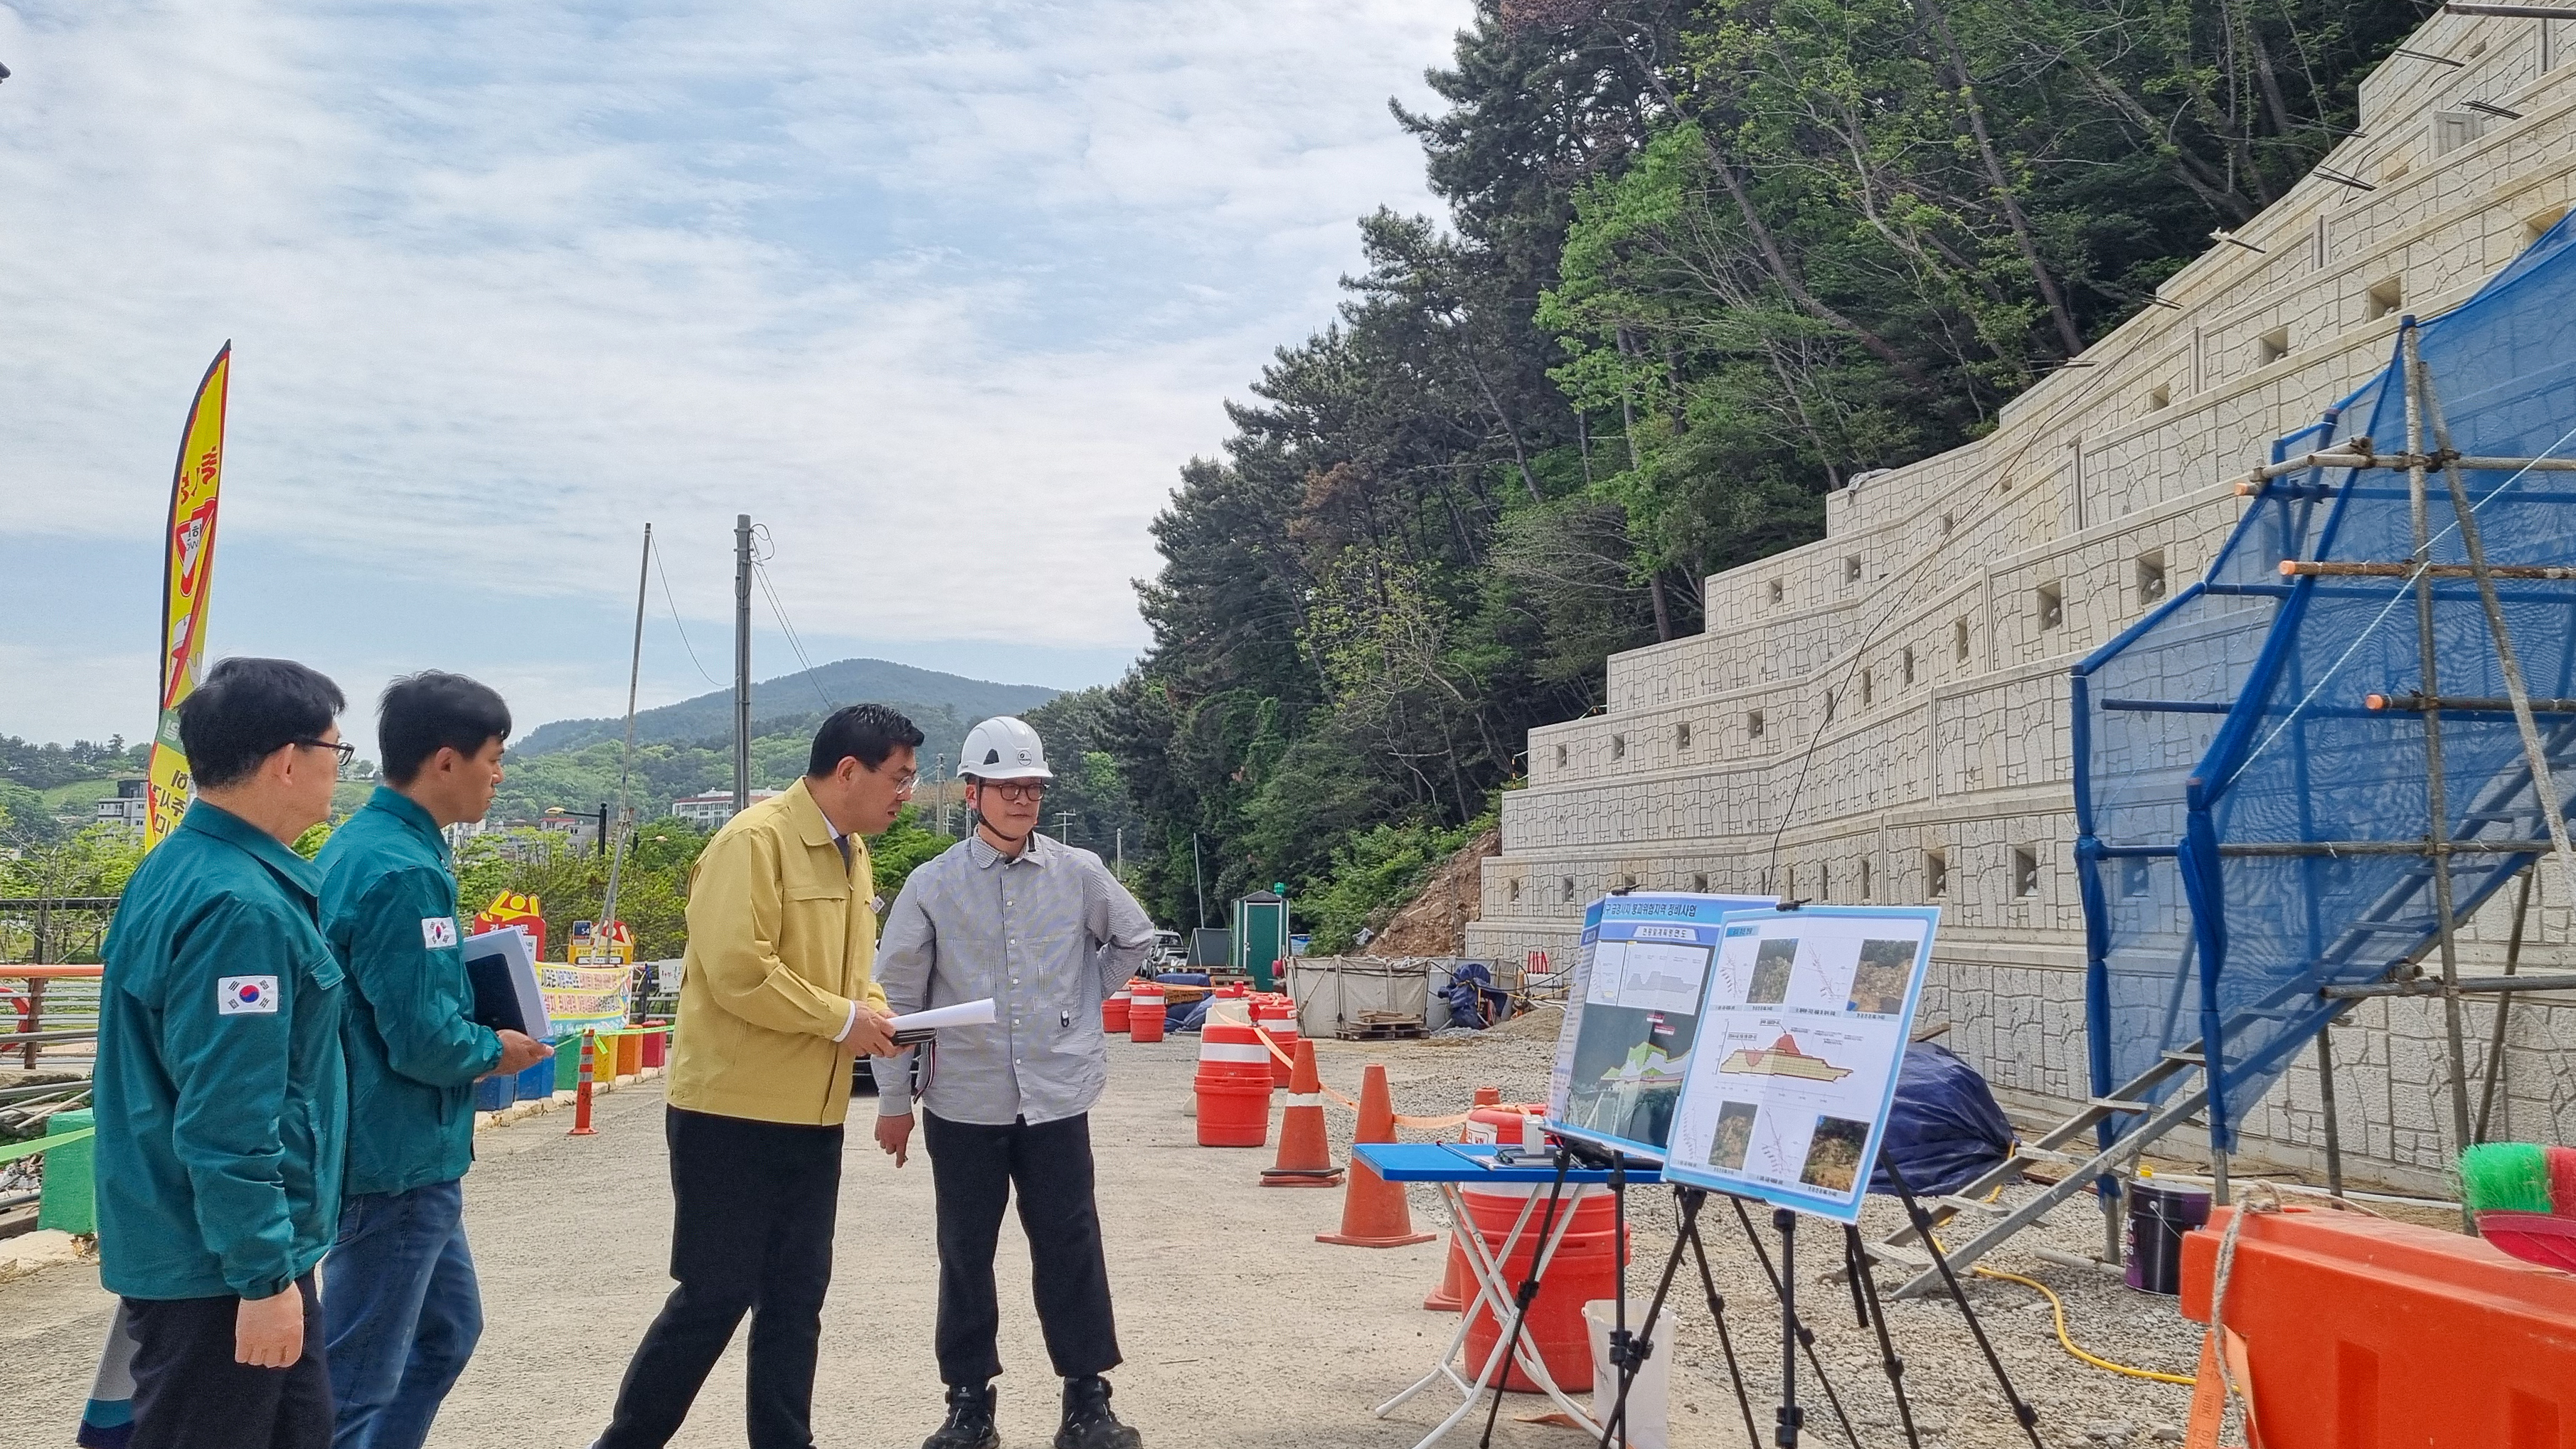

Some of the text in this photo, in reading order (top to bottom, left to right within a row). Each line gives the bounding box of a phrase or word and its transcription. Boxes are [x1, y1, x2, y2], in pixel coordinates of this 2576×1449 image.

[1612, 903, 1631, 915] 급경사지
[1632, 903, 1667, 916] 붕괴위험지역
[1668, 903, 1697, 918] 정비사업
